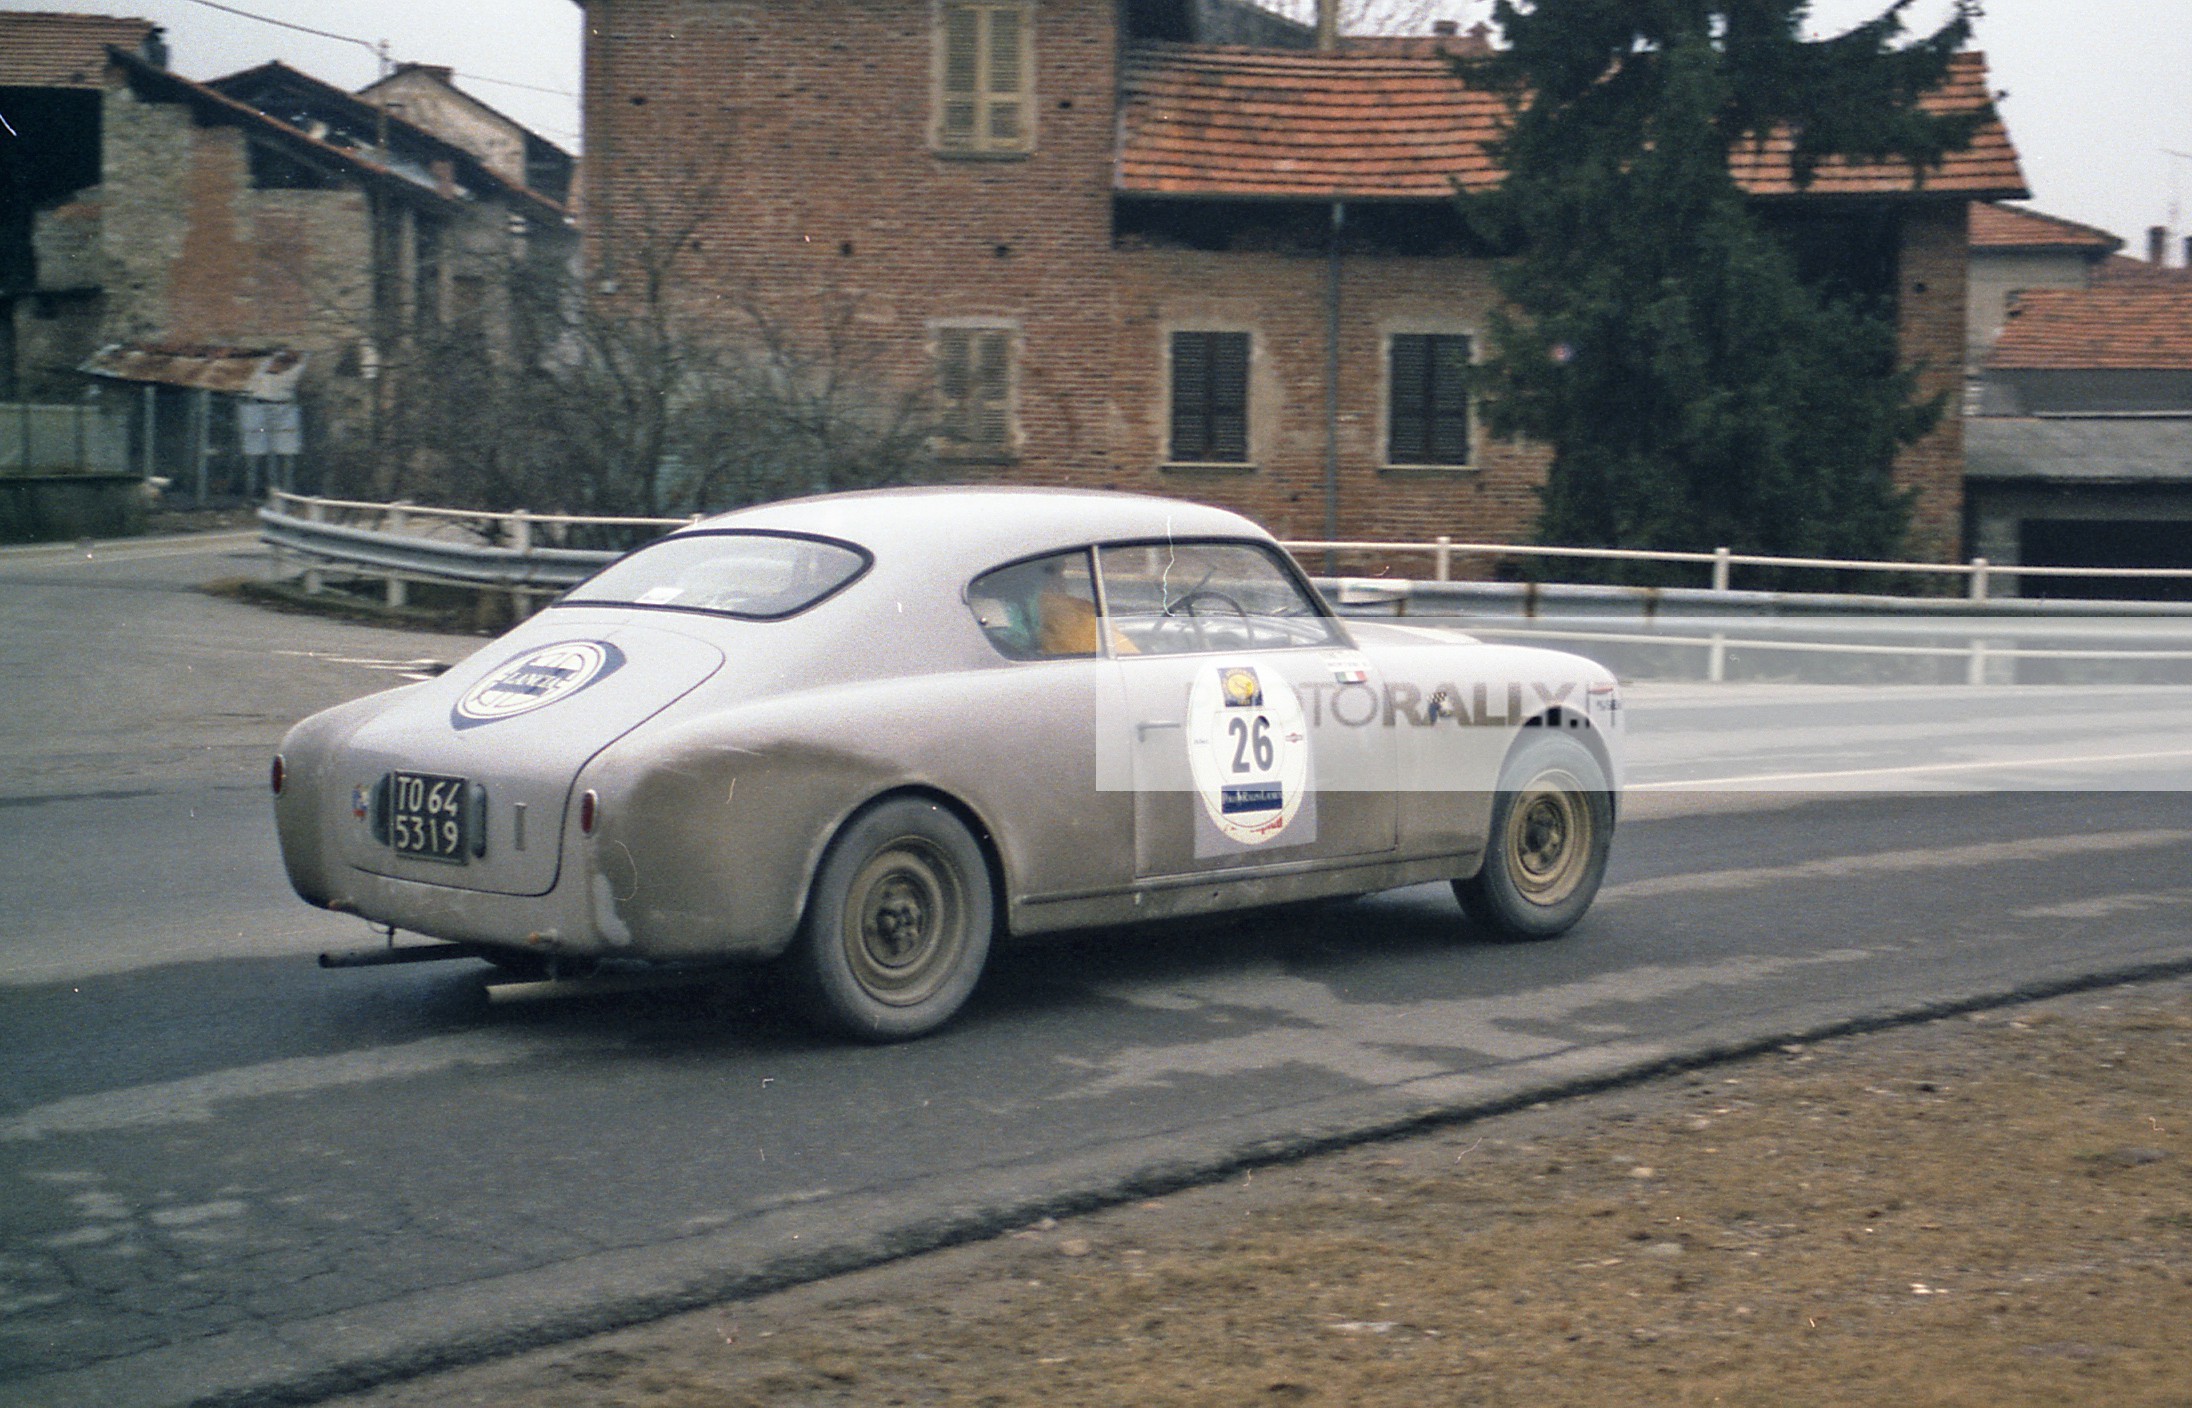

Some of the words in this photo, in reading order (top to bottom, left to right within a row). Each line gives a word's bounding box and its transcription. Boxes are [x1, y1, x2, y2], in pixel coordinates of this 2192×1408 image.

[1228, 715, 1273, 773] 26
[397, 776, 424, 812] TO
[428, 781, 461, 817] 64
[395, 814, 459, 854] 5319
